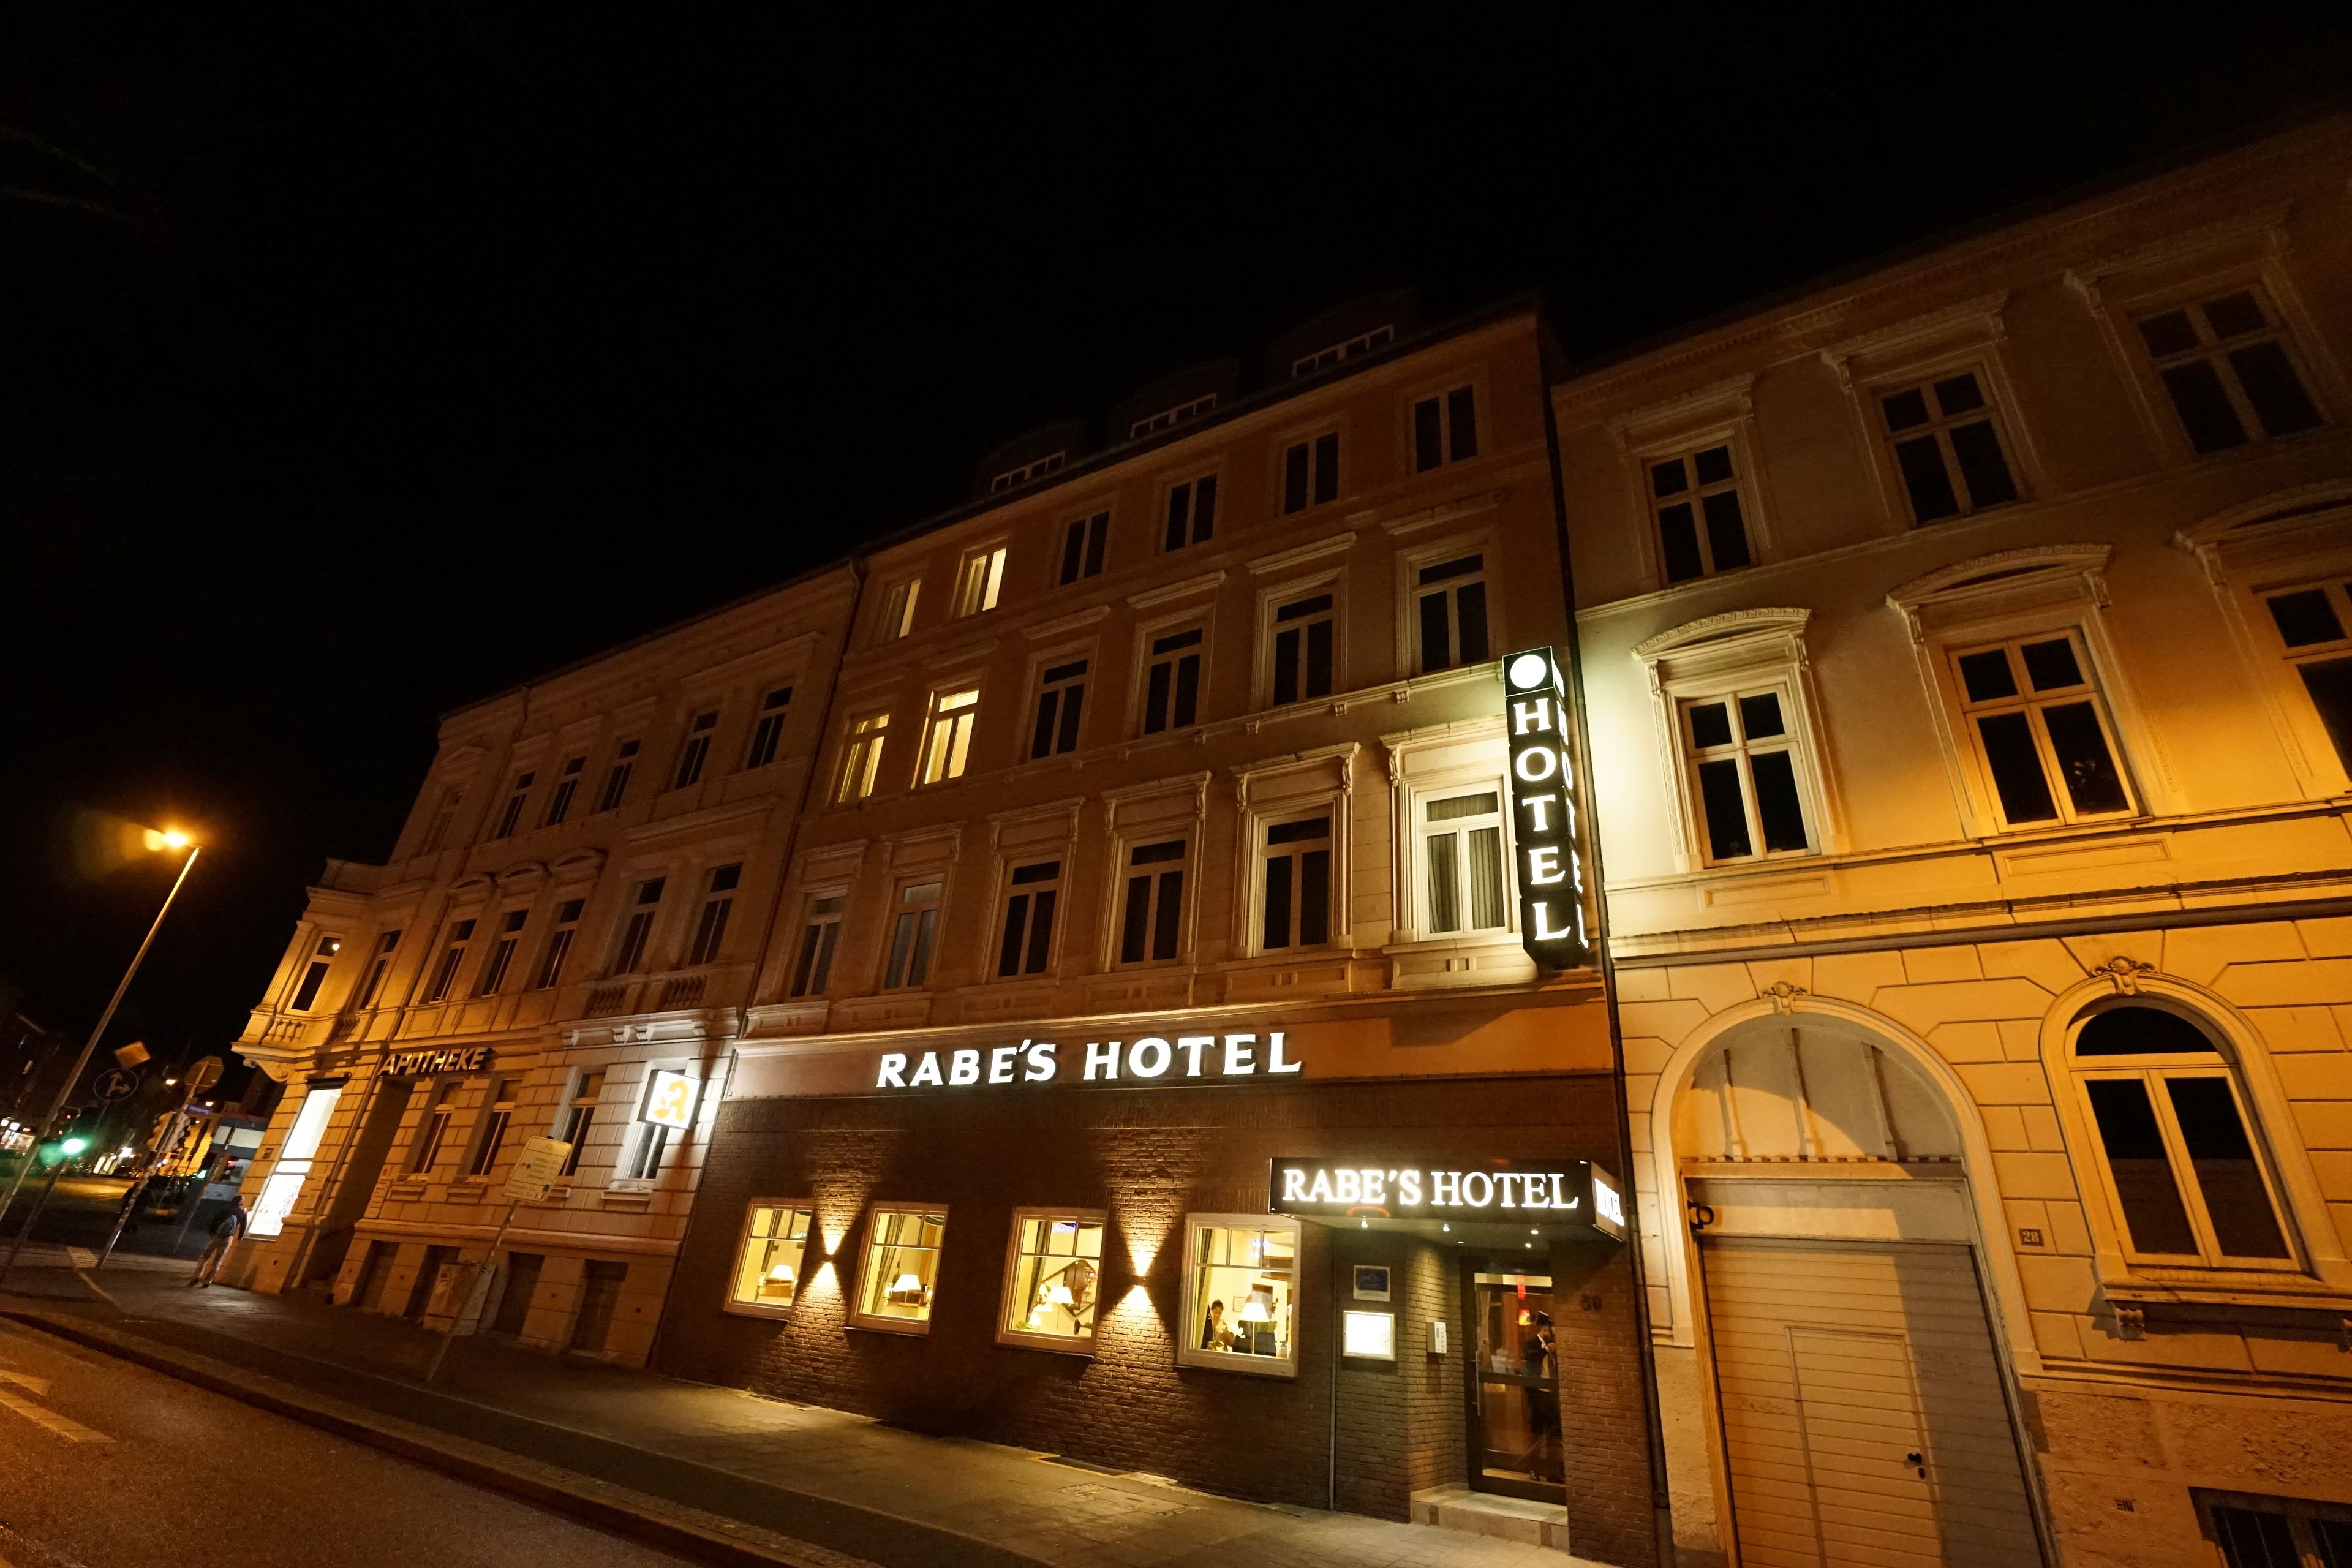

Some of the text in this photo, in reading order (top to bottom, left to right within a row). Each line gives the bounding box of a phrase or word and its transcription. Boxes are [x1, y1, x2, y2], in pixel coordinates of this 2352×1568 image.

[1513, 697, 1571, 941] HOTEL
[377, 1047, 488, 1075] APOTHEKE
[876, 1032, 1302, 1087] RABE'S HOTEL
[1282, 1169, 1579, 1209] RABE'S HOTEL
[2022, 1231, 2039, 1242] 28
